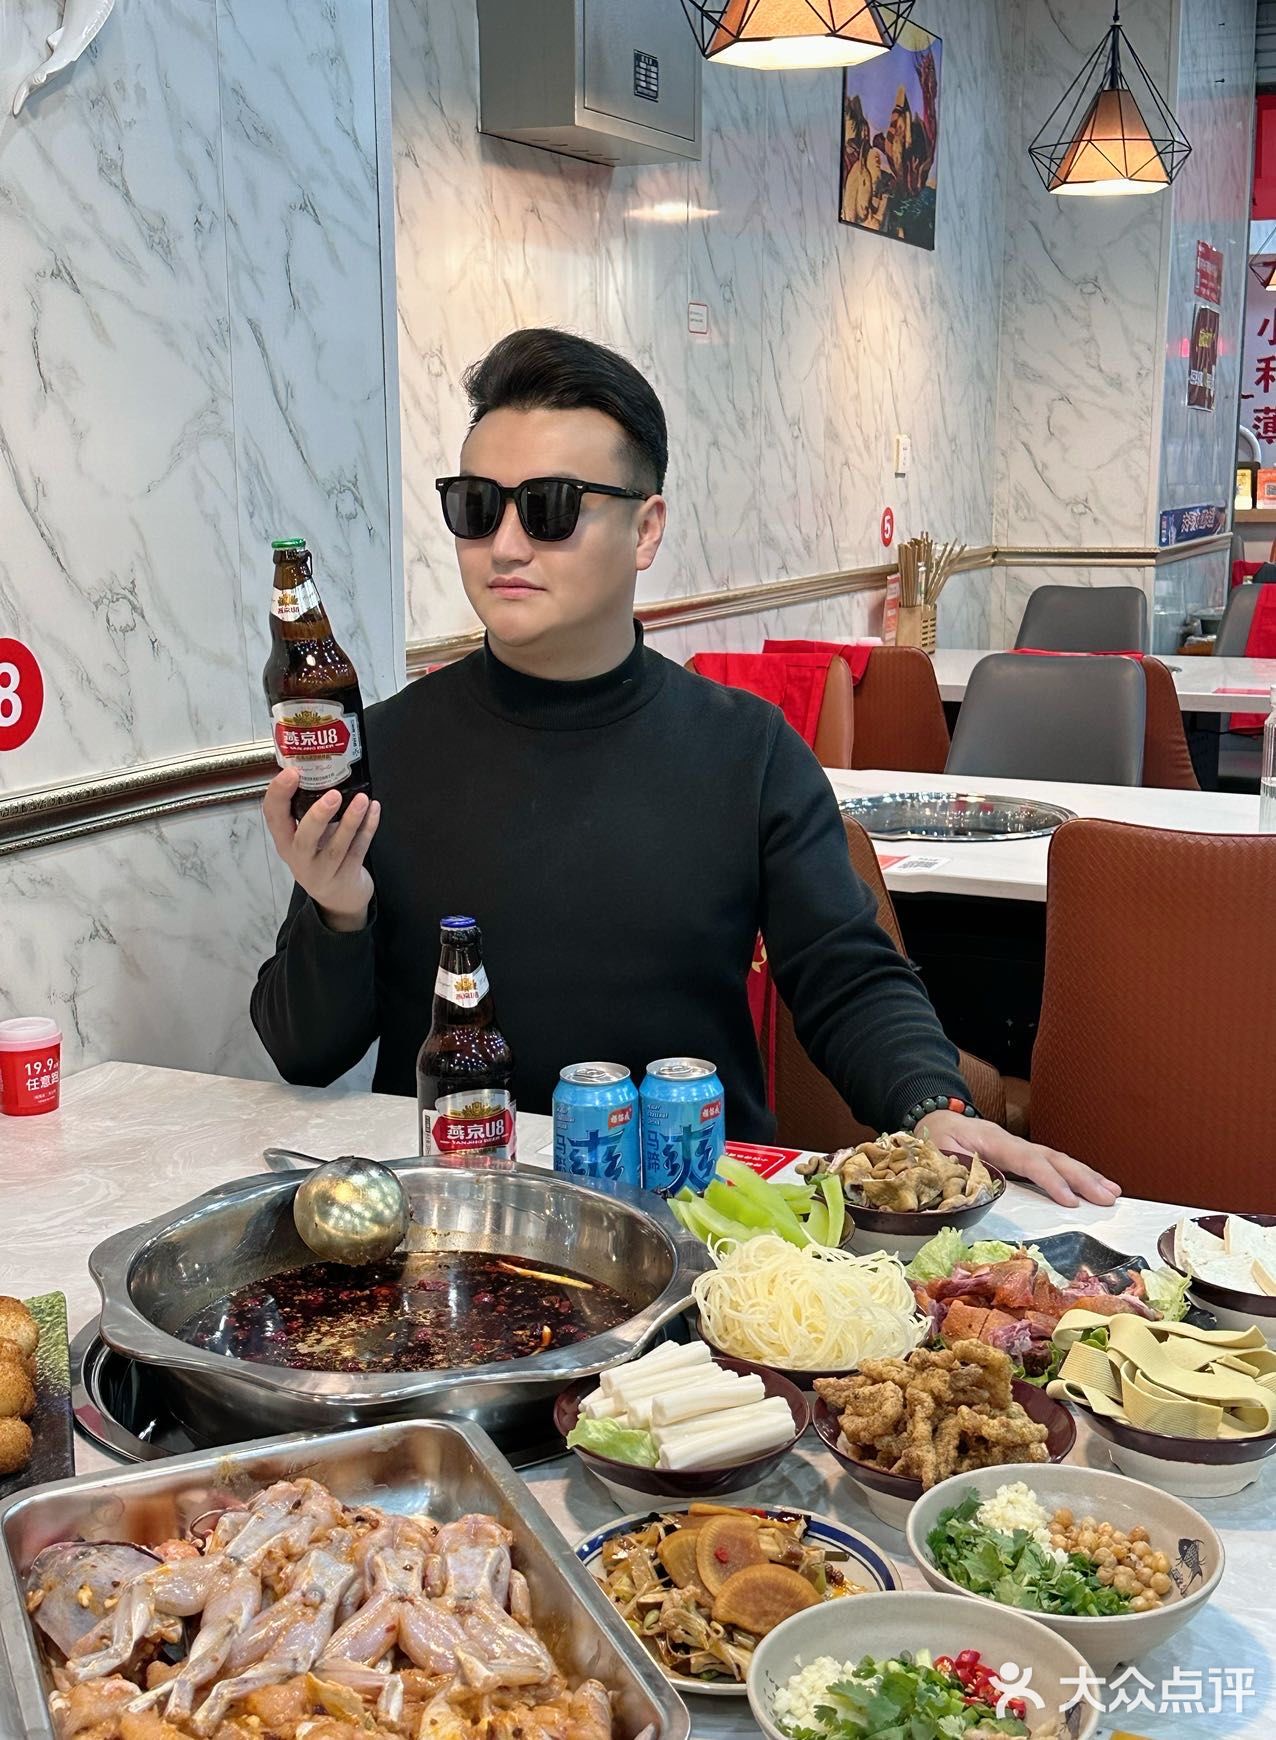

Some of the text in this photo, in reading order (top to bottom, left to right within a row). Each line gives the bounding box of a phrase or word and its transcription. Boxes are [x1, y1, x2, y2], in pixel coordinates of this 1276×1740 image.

[883, 515, 892, 539] 5
[0, 662, 23, 728] 8
[283, 728, 338, 746] 燕京U8
[446, 1119, 504, 1140] 燕京U8
